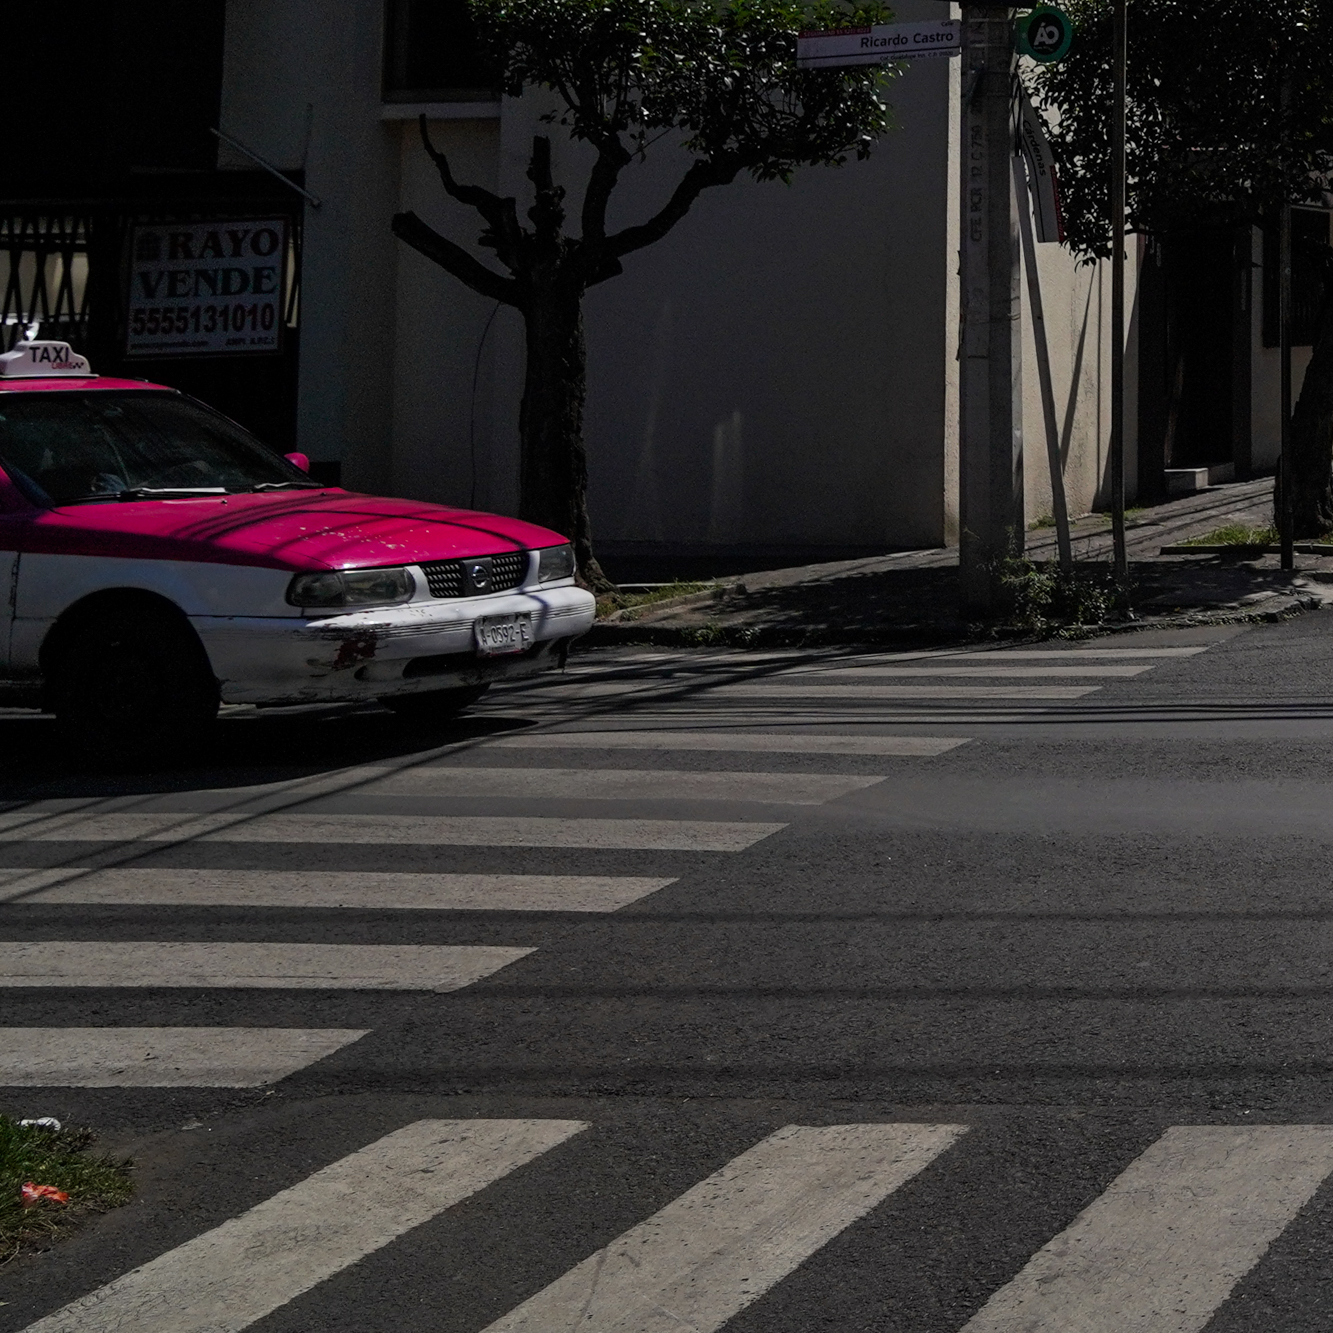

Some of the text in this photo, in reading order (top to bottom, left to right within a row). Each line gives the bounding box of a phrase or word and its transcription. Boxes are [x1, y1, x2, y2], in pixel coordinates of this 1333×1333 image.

[861, 31, 954, 49] Ricardo Castro
[1023, 120, 1046, 177] Cárdenas
[168, 228, 279, 260] RAYO
[137, 267, 278, 299] VENDE
[131, 303, 275, 335] 5555131010
[29, 347, 69, 363] TAXI
